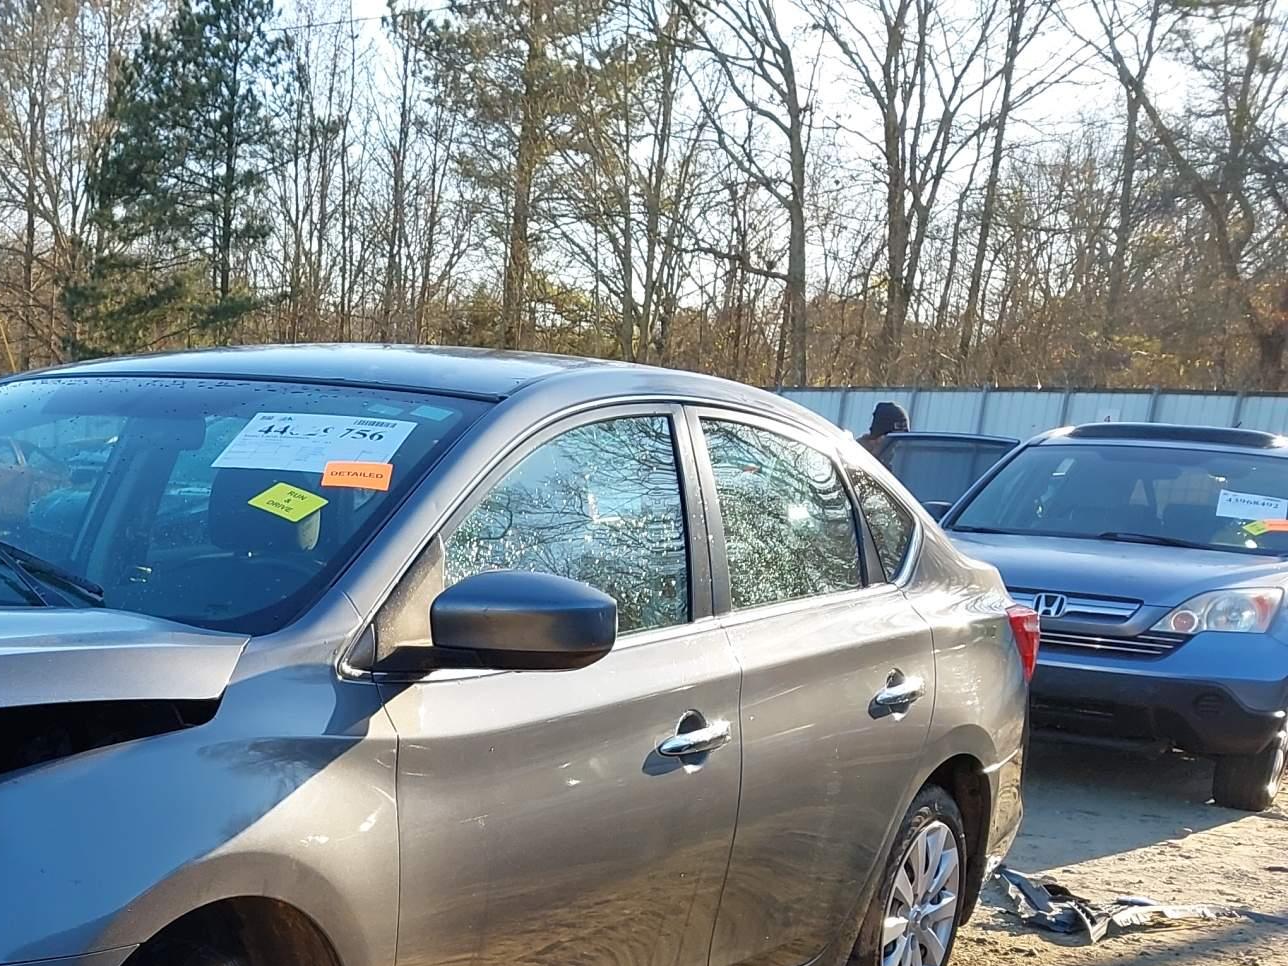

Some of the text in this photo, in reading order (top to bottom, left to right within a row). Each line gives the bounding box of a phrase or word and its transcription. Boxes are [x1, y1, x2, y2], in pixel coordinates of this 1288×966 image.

[257, 424, 386, 442] 44756
[330, 470, 384, 479] DETAILED
[287, 490, 308, 501] RUN
[265, 499, 294, 513] DRIVE
